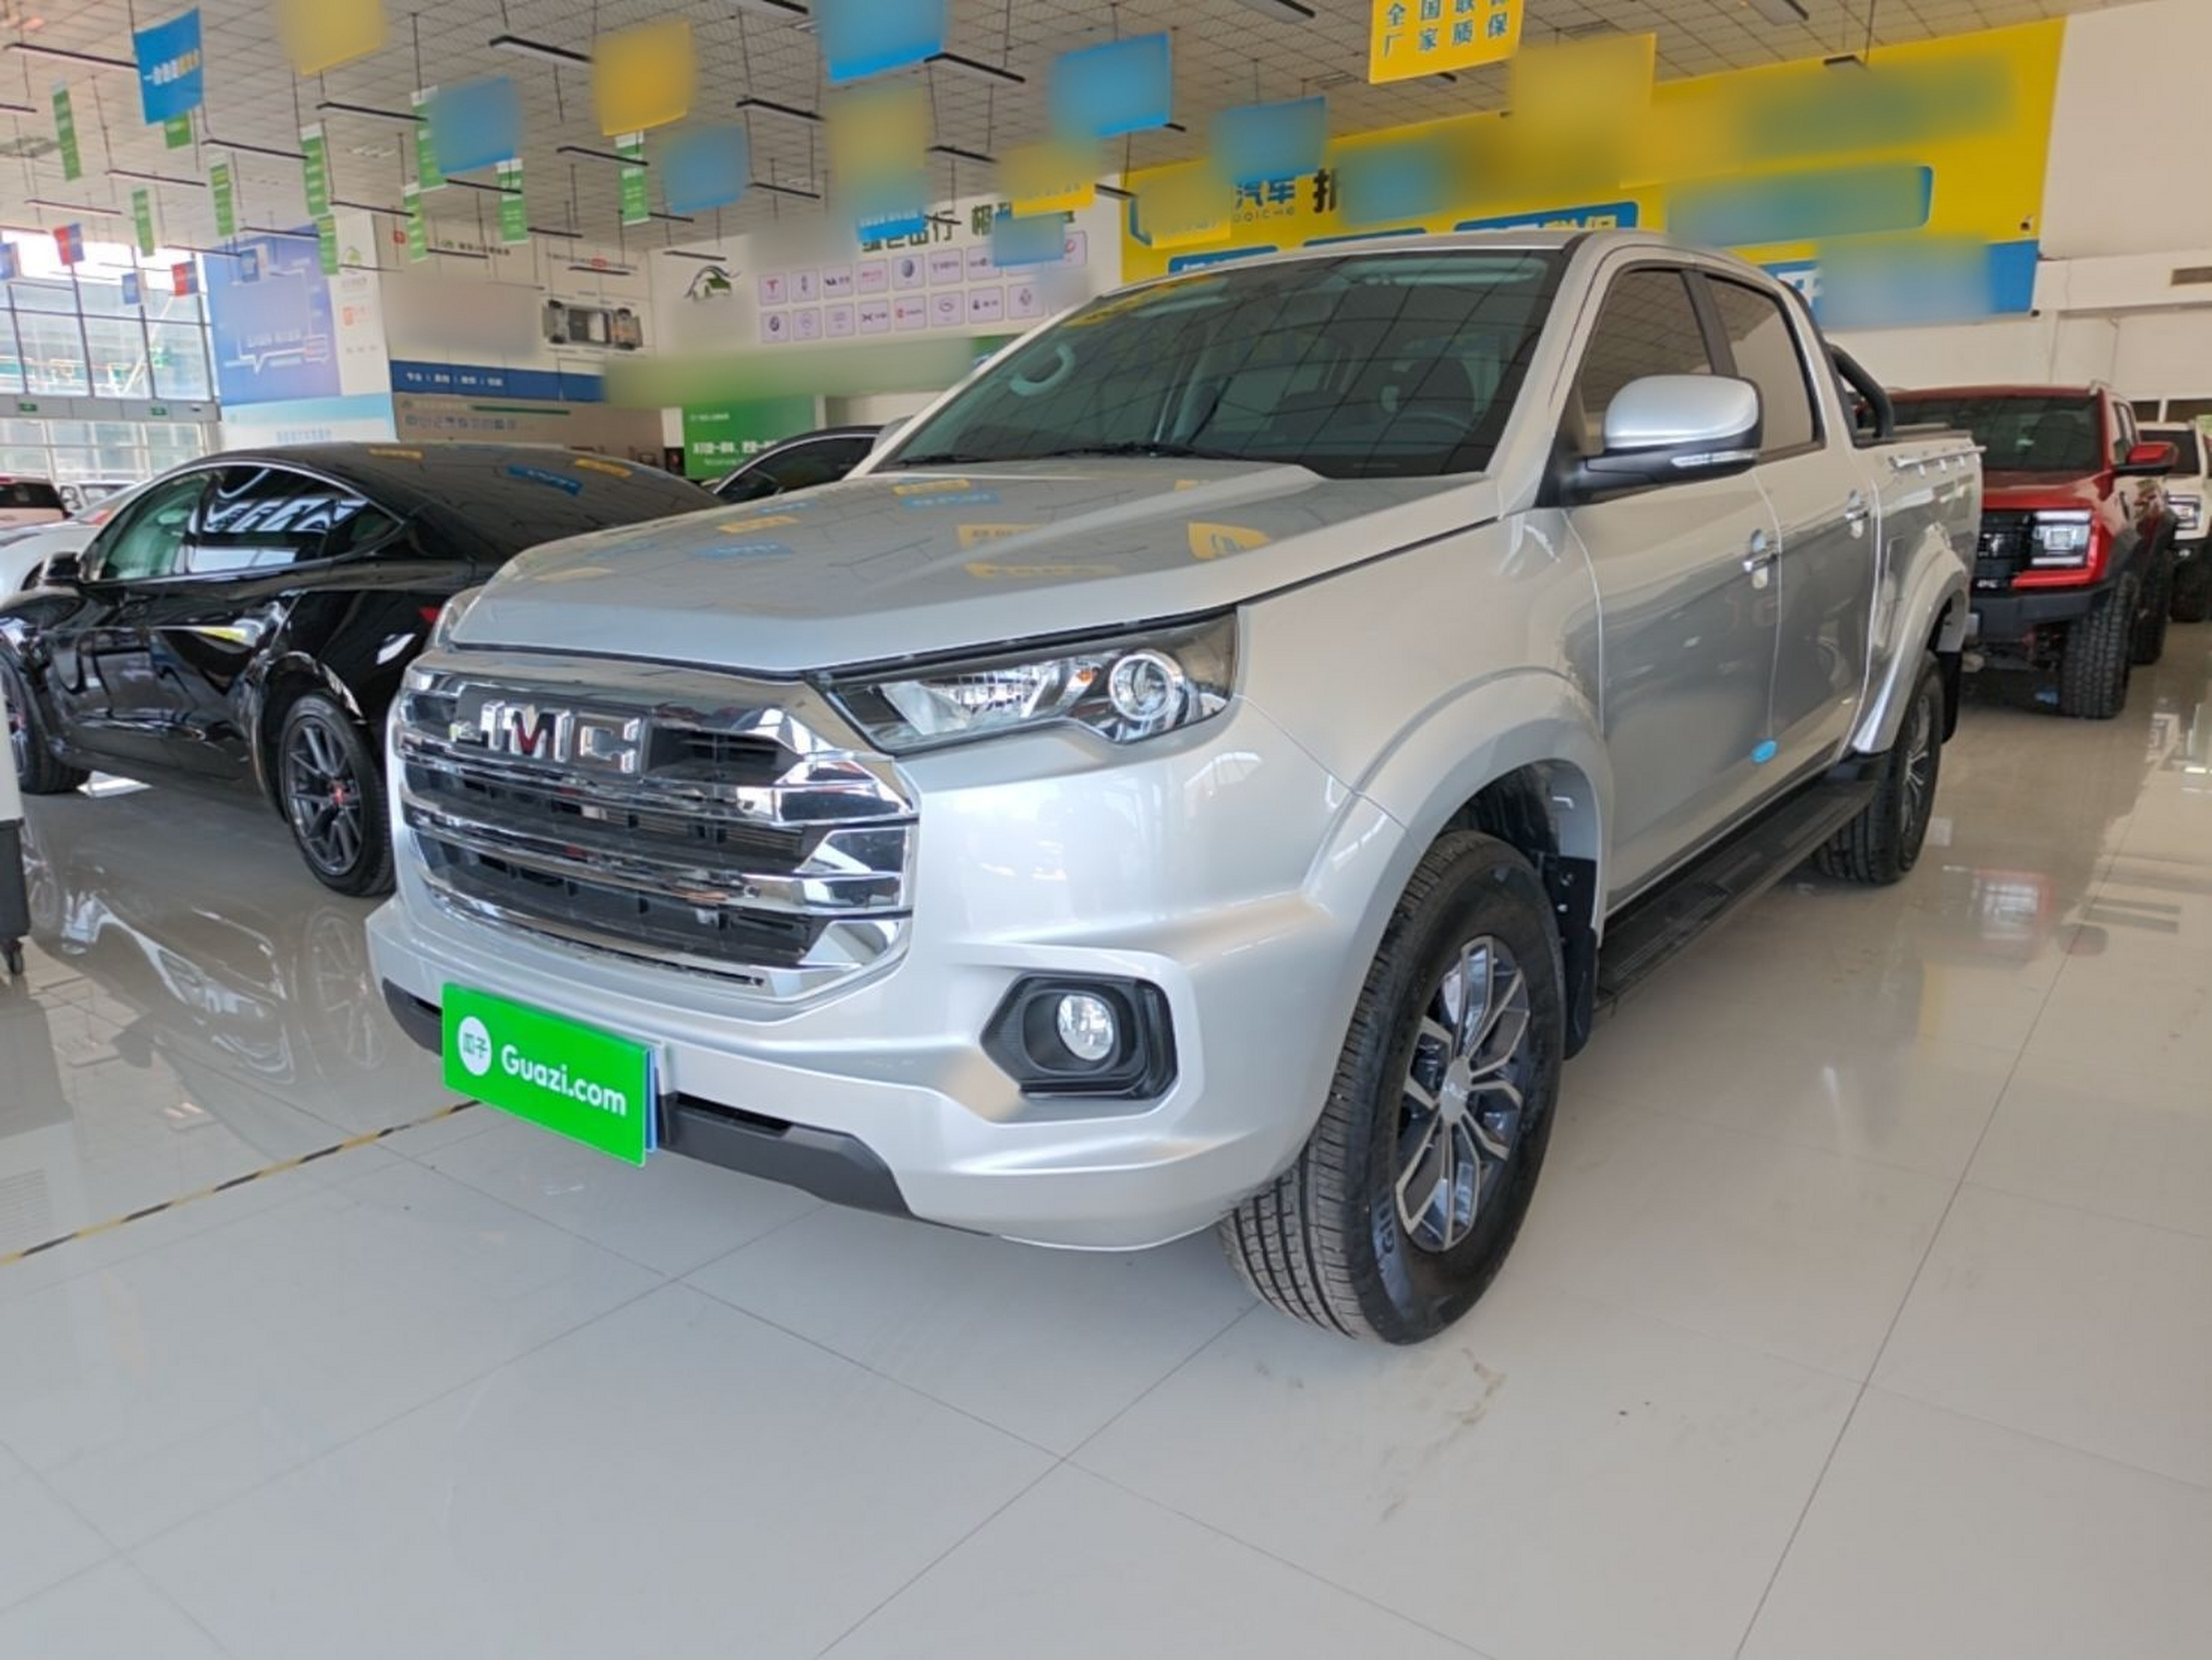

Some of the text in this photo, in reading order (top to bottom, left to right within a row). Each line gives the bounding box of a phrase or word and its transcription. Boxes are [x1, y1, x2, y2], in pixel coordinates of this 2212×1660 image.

[1384, 12, 1508, 58] 厂家质保
[1387, 0, 1508, 27] 全国联
[449, 699, 641, 774] JMC
